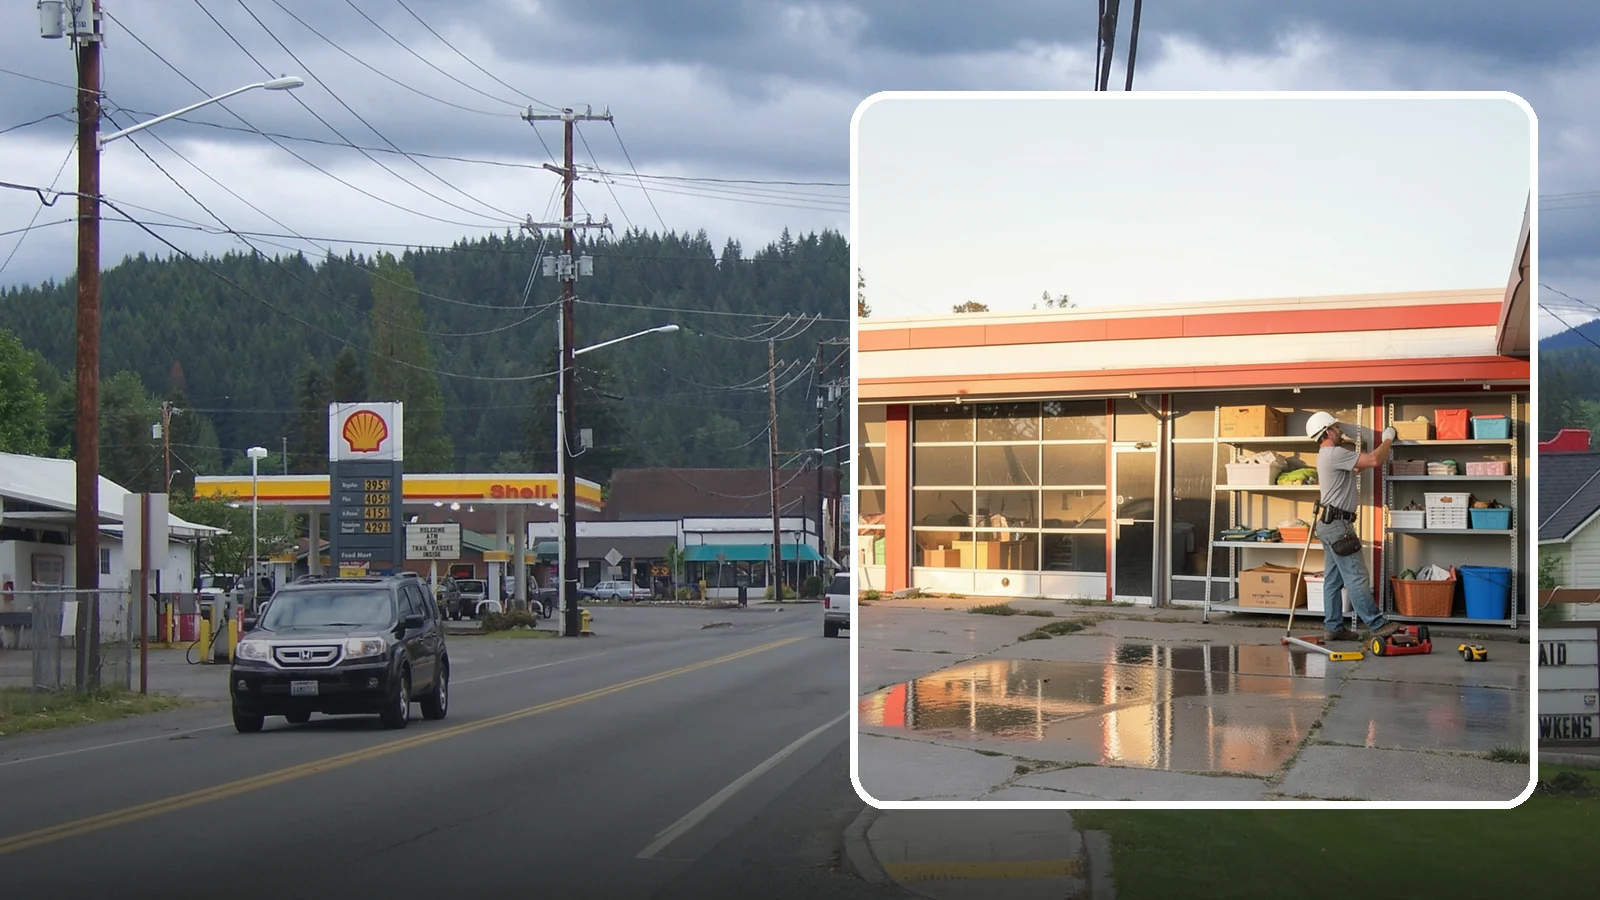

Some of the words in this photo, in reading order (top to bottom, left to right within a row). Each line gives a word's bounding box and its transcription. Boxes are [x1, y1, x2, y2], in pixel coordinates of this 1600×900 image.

[366, 480, 383, 490] 395
[490, 484, 547, 499] Shell
[366, 494, 383, 504] 405
[365, 508, 383, 518] 415
[366, 522, 383, 533] 429
[1539, 643, 1566, 665] AID
